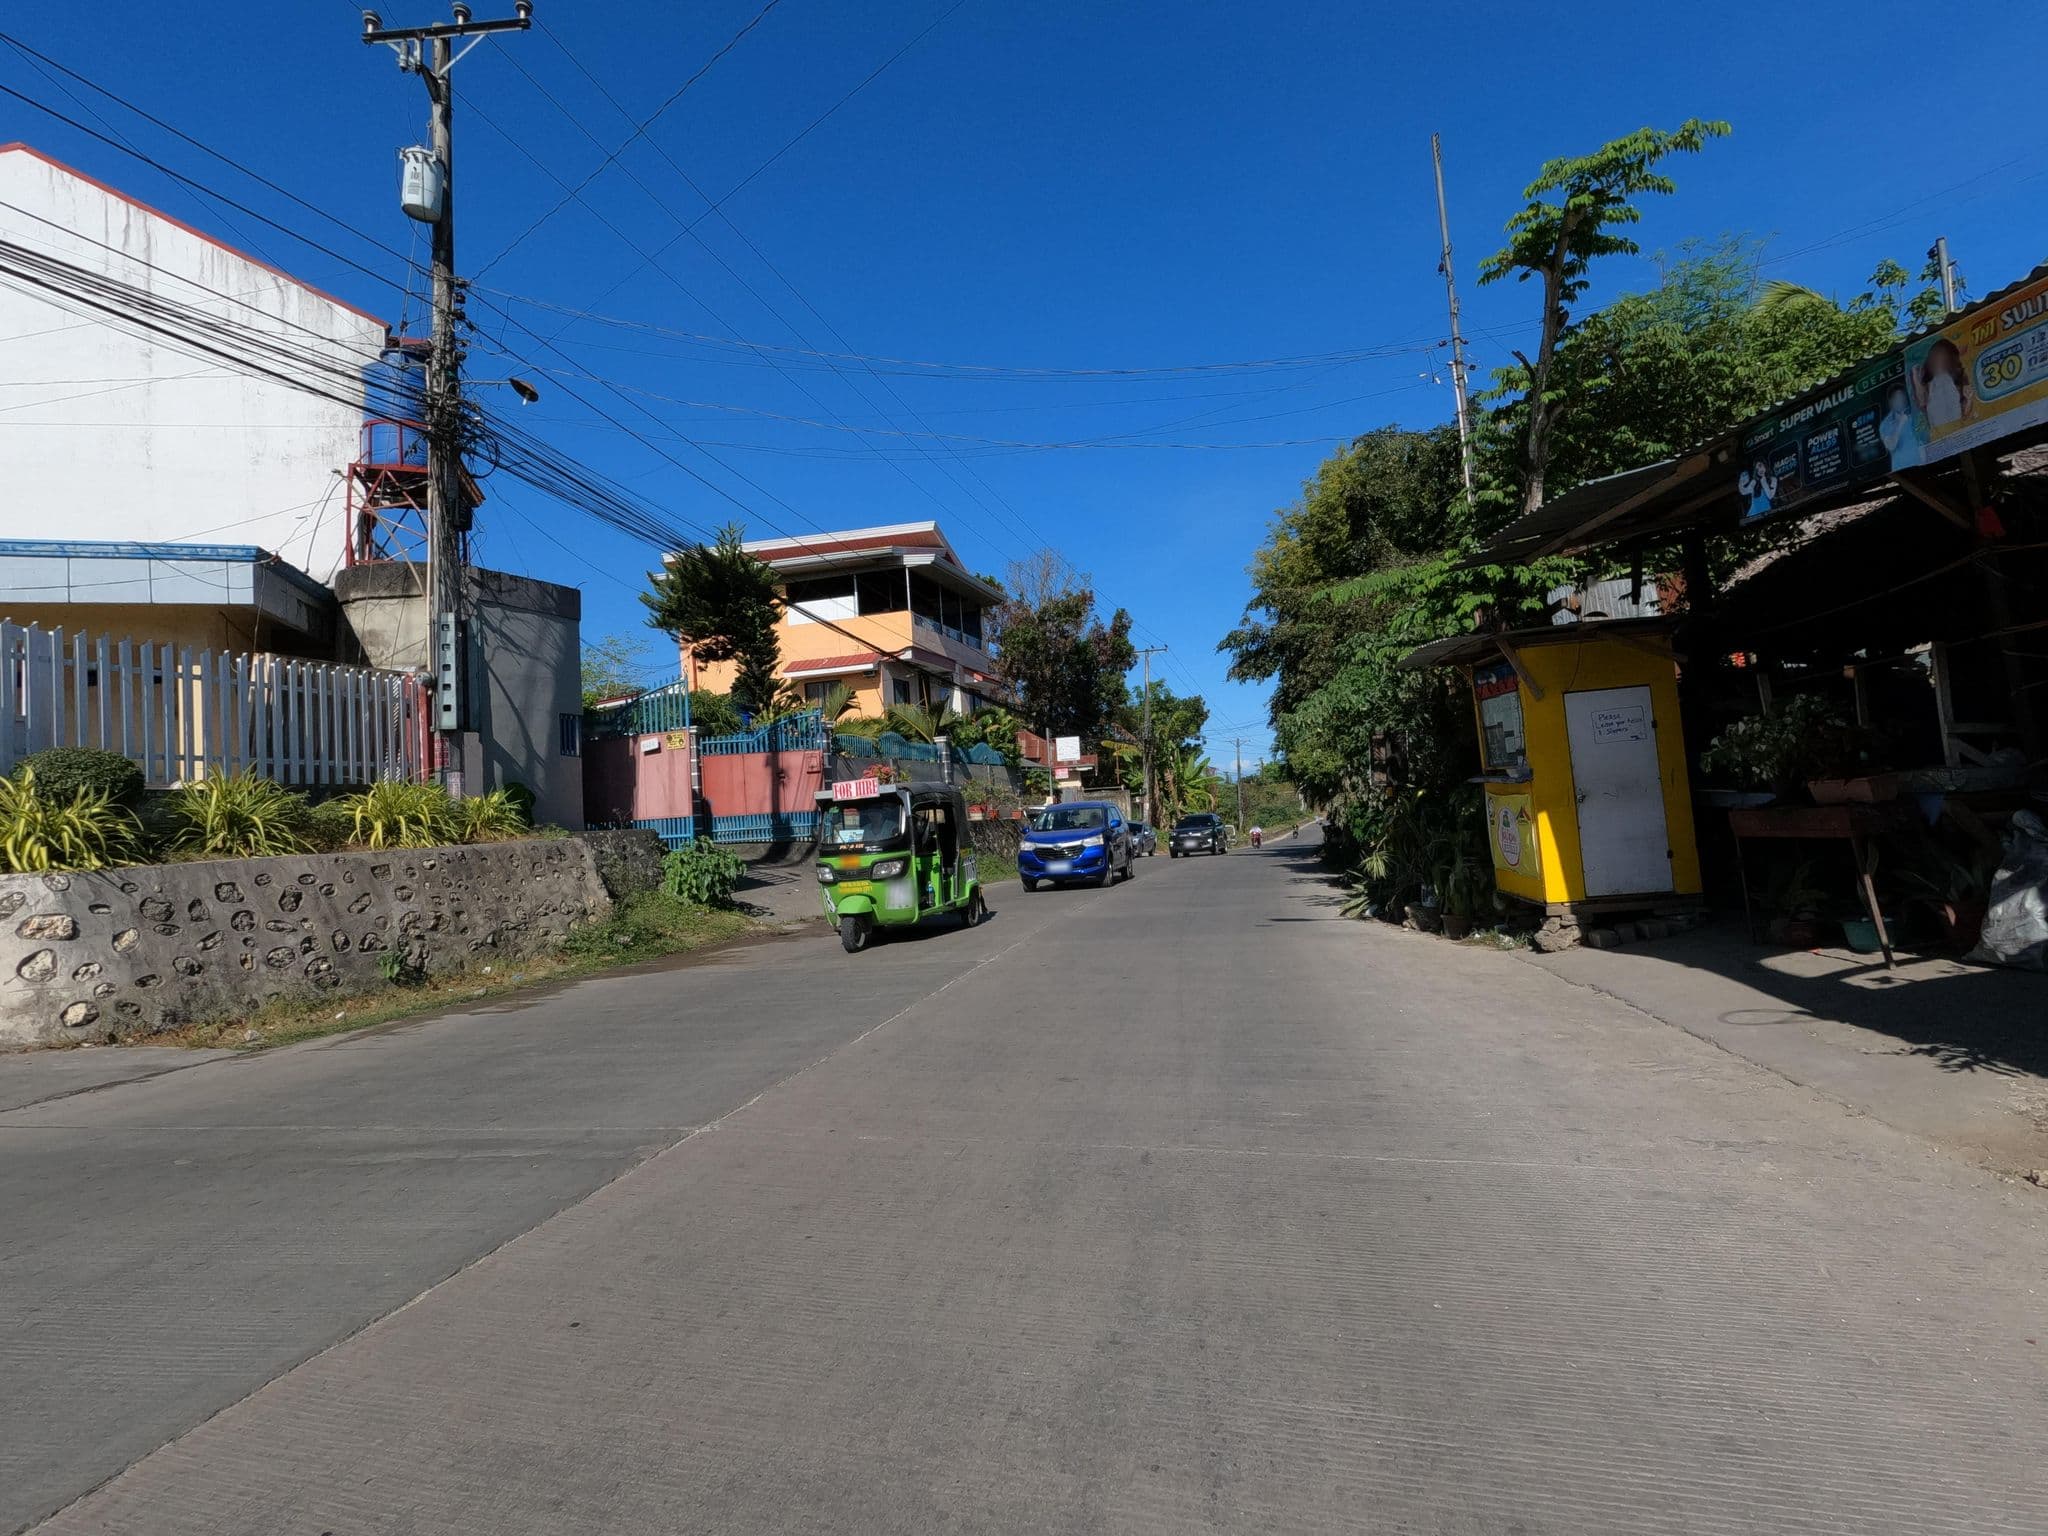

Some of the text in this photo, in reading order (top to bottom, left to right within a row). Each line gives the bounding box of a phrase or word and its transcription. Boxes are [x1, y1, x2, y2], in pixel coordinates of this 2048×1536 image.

[1971, 317, 1997, 345] TNT
[1862, 363, 1903, 390] DEALS
[1983, 353, 2022, 388] 30
[1779, 385, 1856, 433] SUPER VALUE
[1754, 427, 1775, 446] Smart
[1808, 428, 1839, 449] POWER
[834, 779, 877, 800] FOR HIRE
